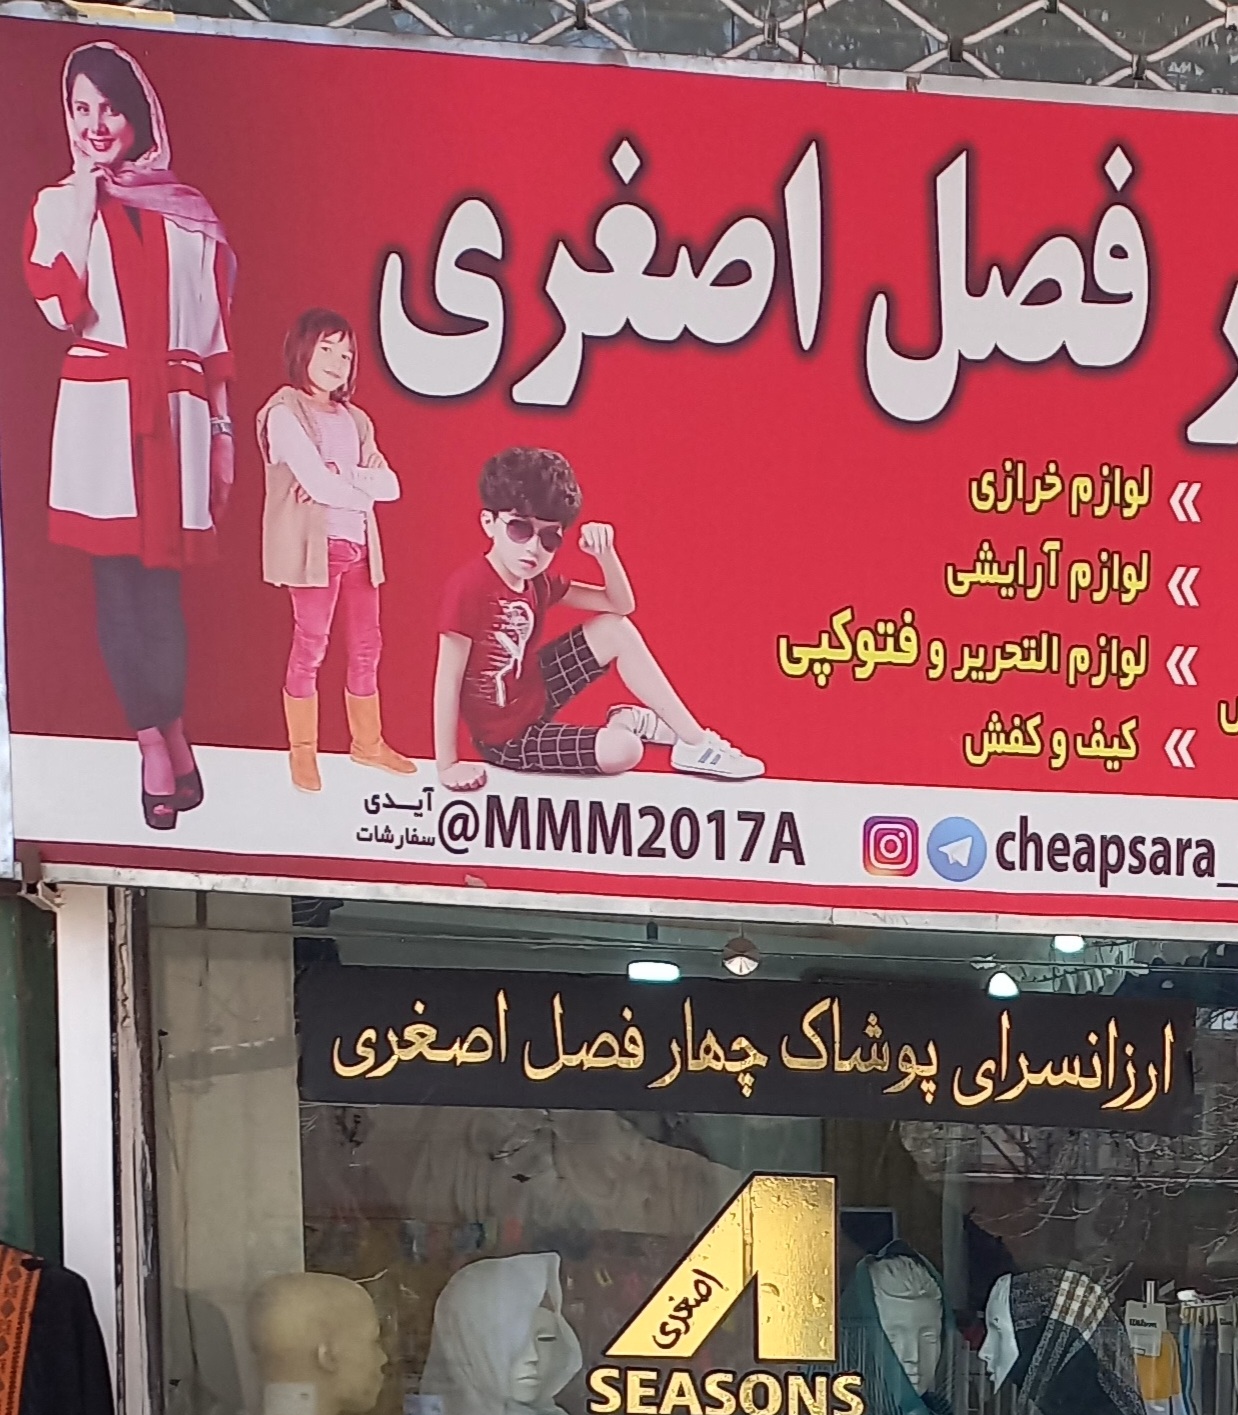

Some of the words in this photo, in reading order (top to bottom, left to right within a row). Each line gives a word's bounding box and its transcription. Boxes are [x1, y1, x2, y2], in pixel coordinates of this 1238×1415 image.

[378, 137, 823, 408] اصغری
[864, 144, 1152, 424] فصل
[967, 457, 1064, 515] خرازی
[1067, 461, 1152, 519] لوازم
[944, 537, 1064, 600] آرایشی
[1067, 547, 1152, 605] لوازم
[776, 605, 920, 690] فتوکپی
[925, 635, 947, 681] و
[952, 629, 1062, 684] التحریر
[1065, 632, 1149, 689] لوازم
[961, 710, 1044, 768] کفش
[1047, 726, 1068, 771] و
[1072, 716, 1140, 773] کیف
[363, 787, 436, 820] آیدی
[436, 793, 807, 867] @MMM2017A
[355, 822, 436, 851] سفارشات
[331, 988, 509, 1079] اصغری
[522, 991, 646, 1082] فصل
[646, 995, 769, 1099] چهار
[780, 995, 940, 1105] پوشاک
[952, 1008, 1175, 1111] ارزانسرای
